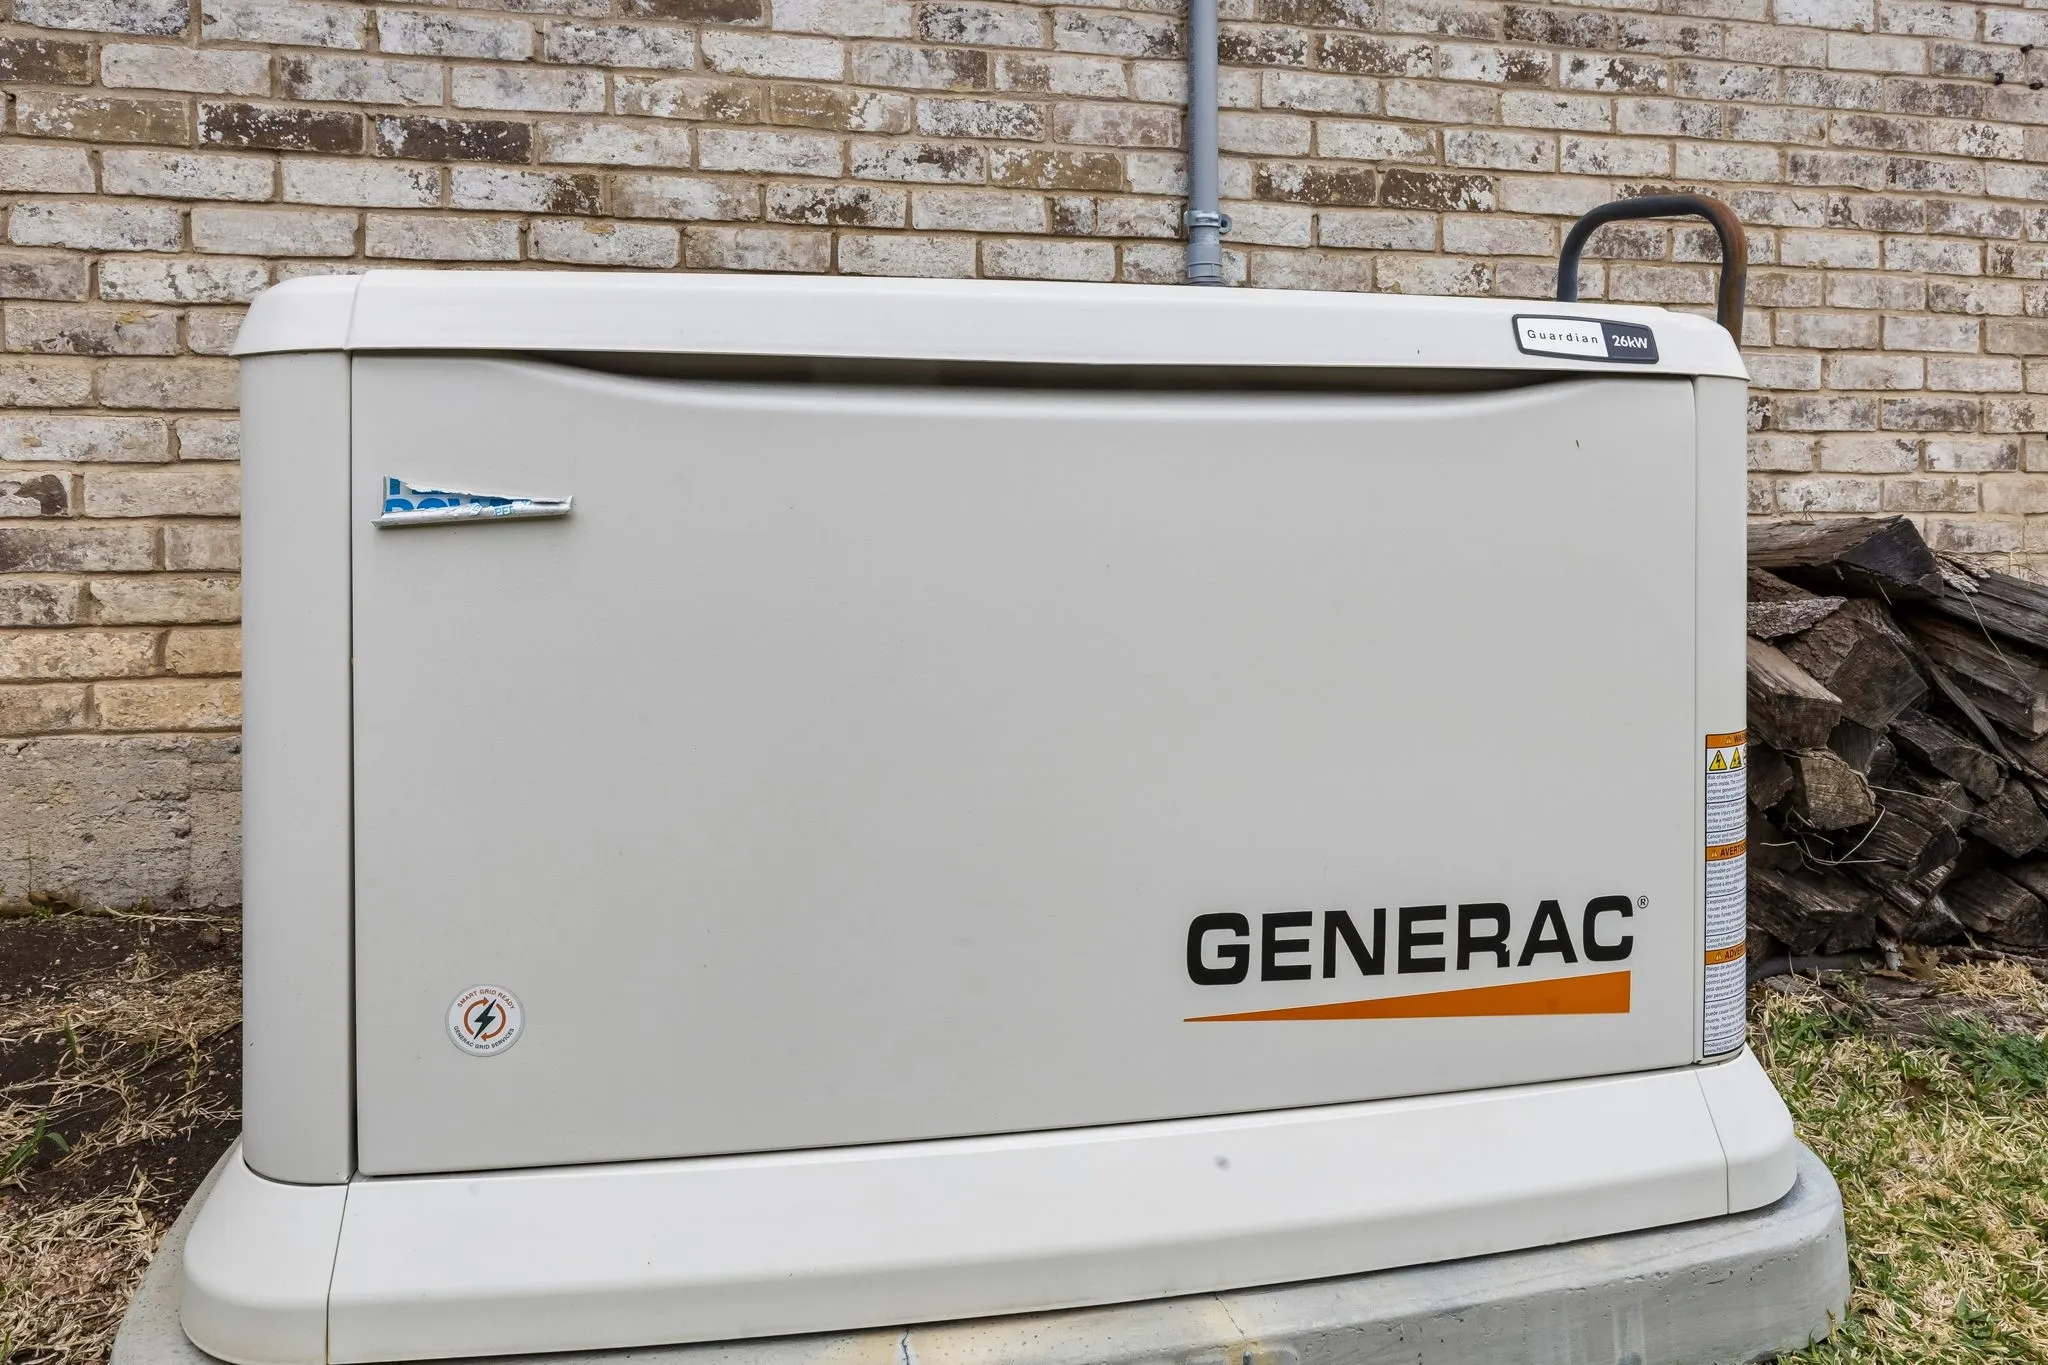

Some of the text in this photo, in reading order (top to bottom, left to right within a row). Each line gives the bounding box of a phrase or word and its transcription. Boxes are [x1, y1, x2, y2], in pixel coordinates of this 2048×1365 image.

[1527, 329, 1648, 349] Guardian 26kW
[457, 990, 477, 1008] SMART
[498, 992, 516, 1009] READY
[454, 1026, 474, 1047] GENERAC
[491, 1028, 514, 1048] SERVICES
